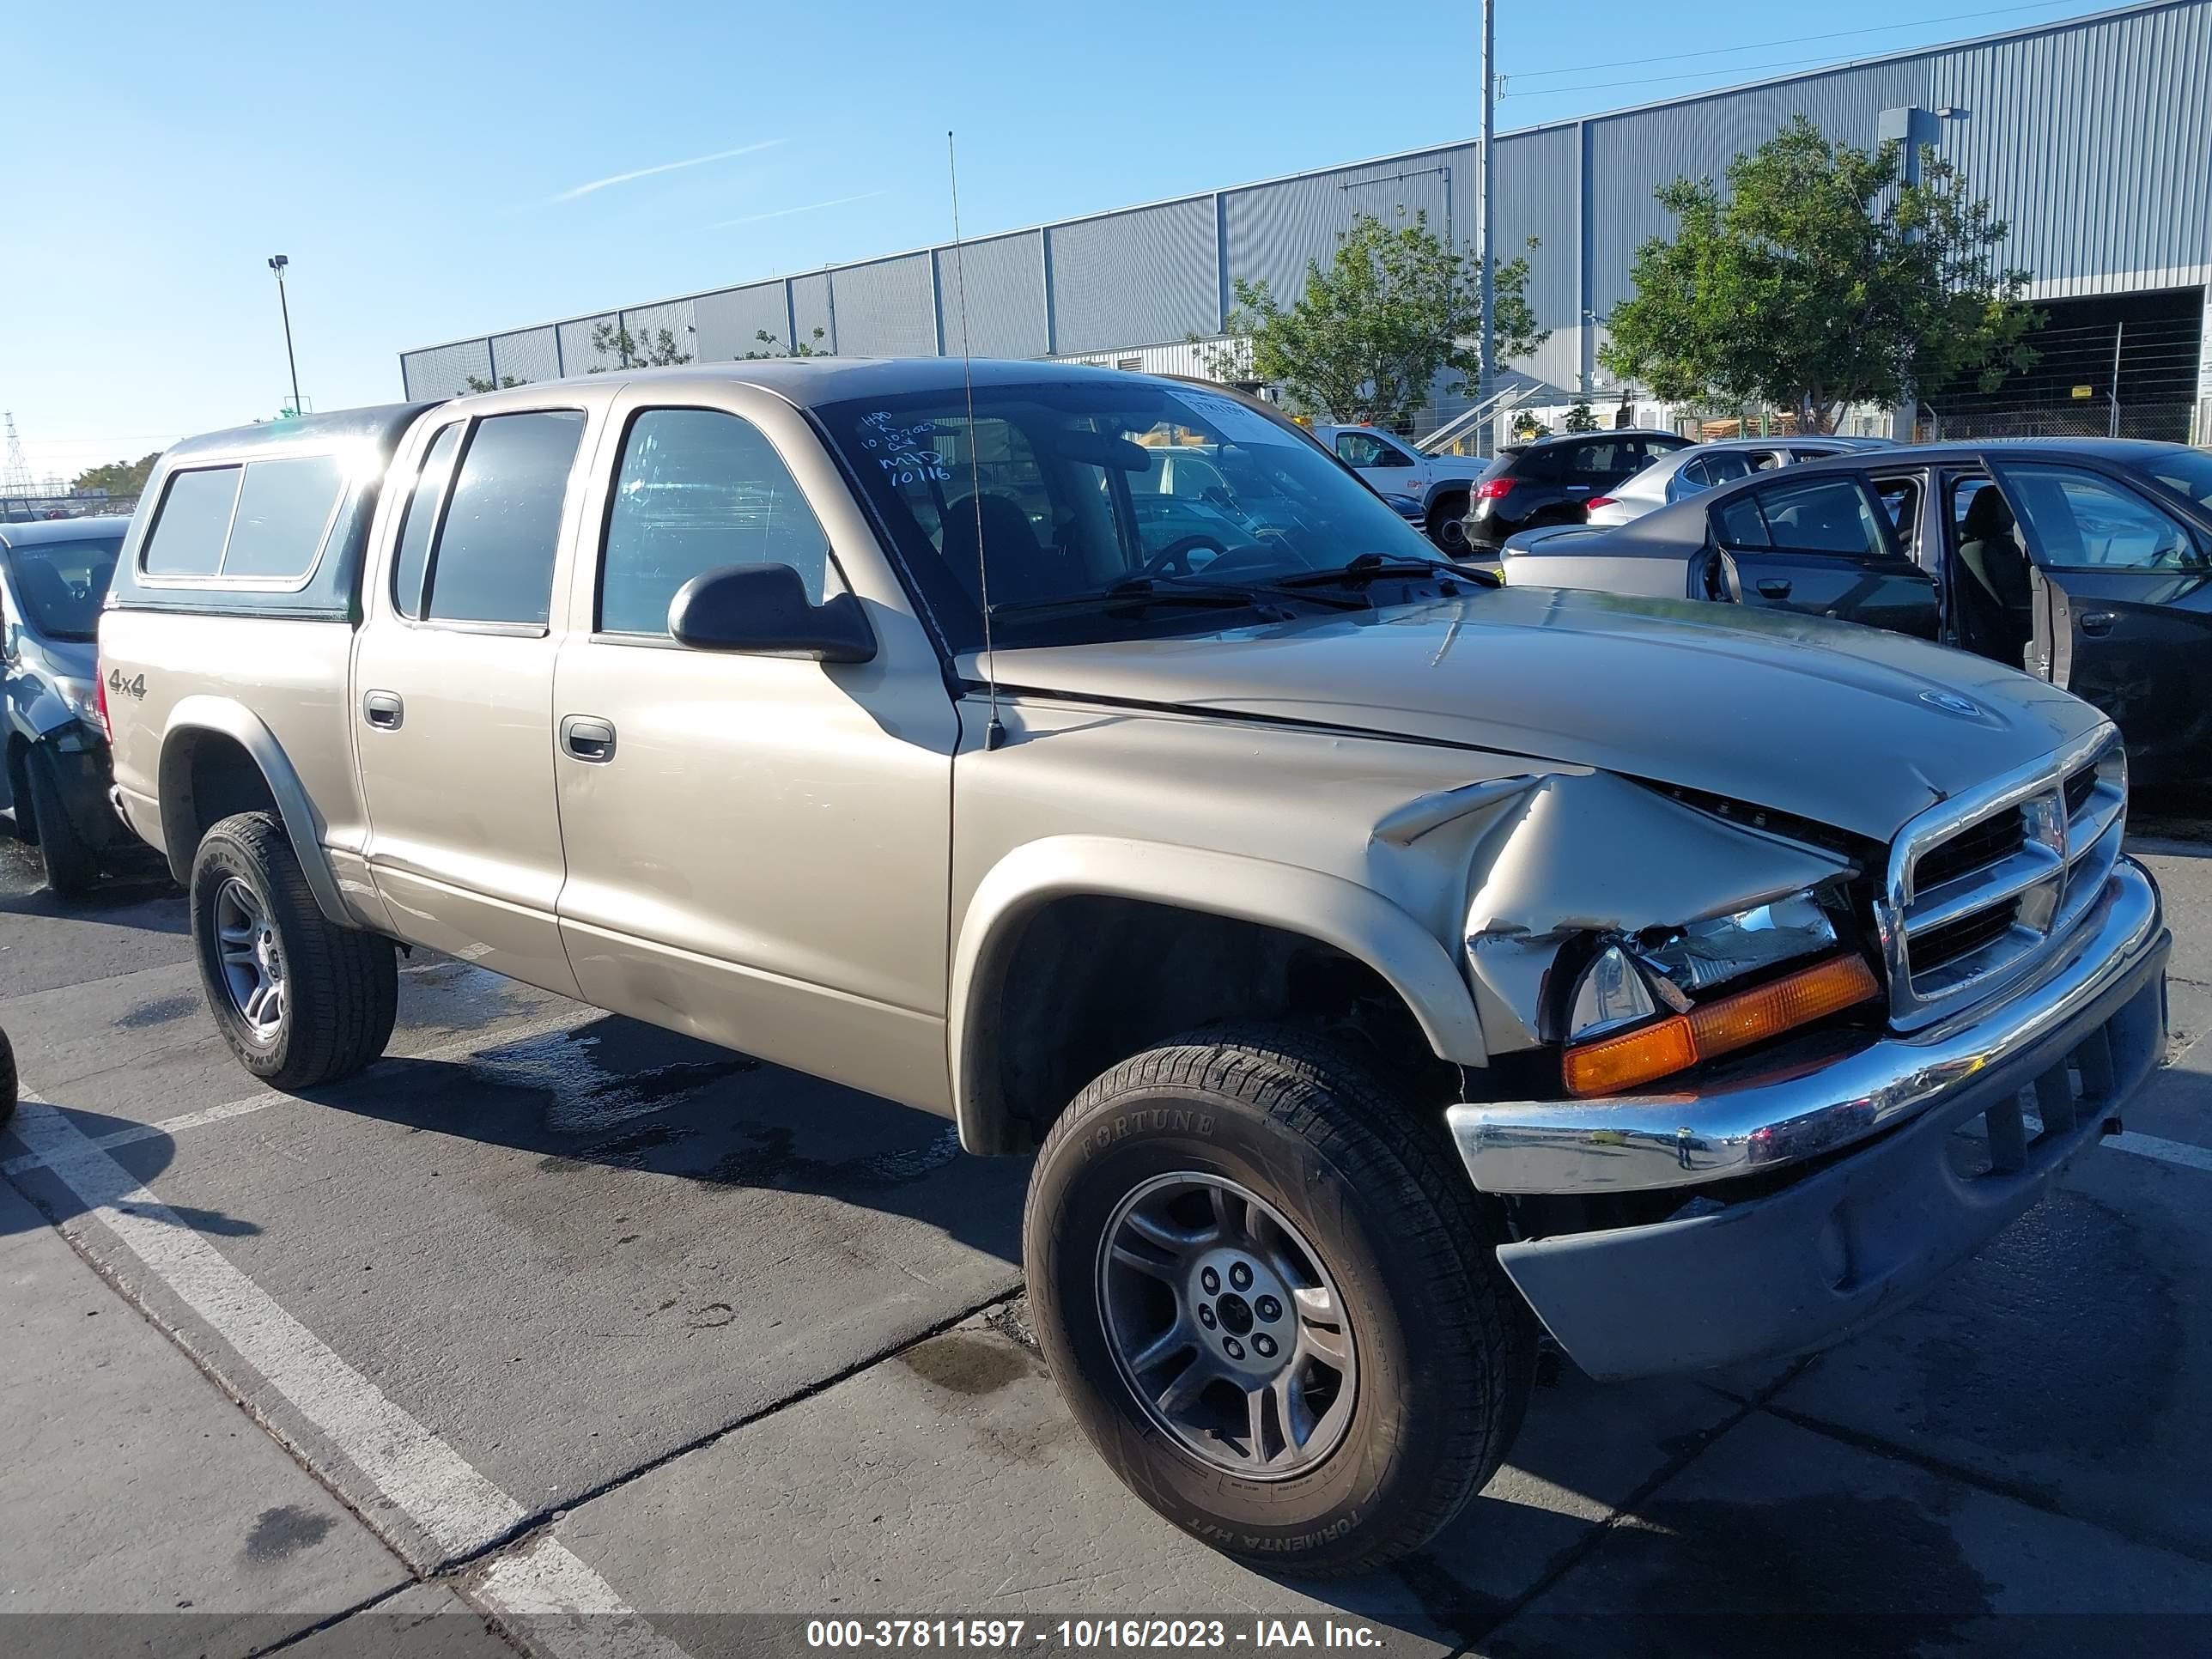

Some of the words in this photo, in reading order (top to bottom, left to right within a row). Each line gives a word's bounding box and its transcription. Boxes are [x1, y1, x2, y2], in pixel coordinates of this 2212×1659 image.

[108, 668, 148, 699] 4x4
[1079, 1108, 1218, 1162] FORTUNE
[1185, 1517, 1235, 1543] H/T
[1243, 1510, 1364, 1553] TORMENTA
